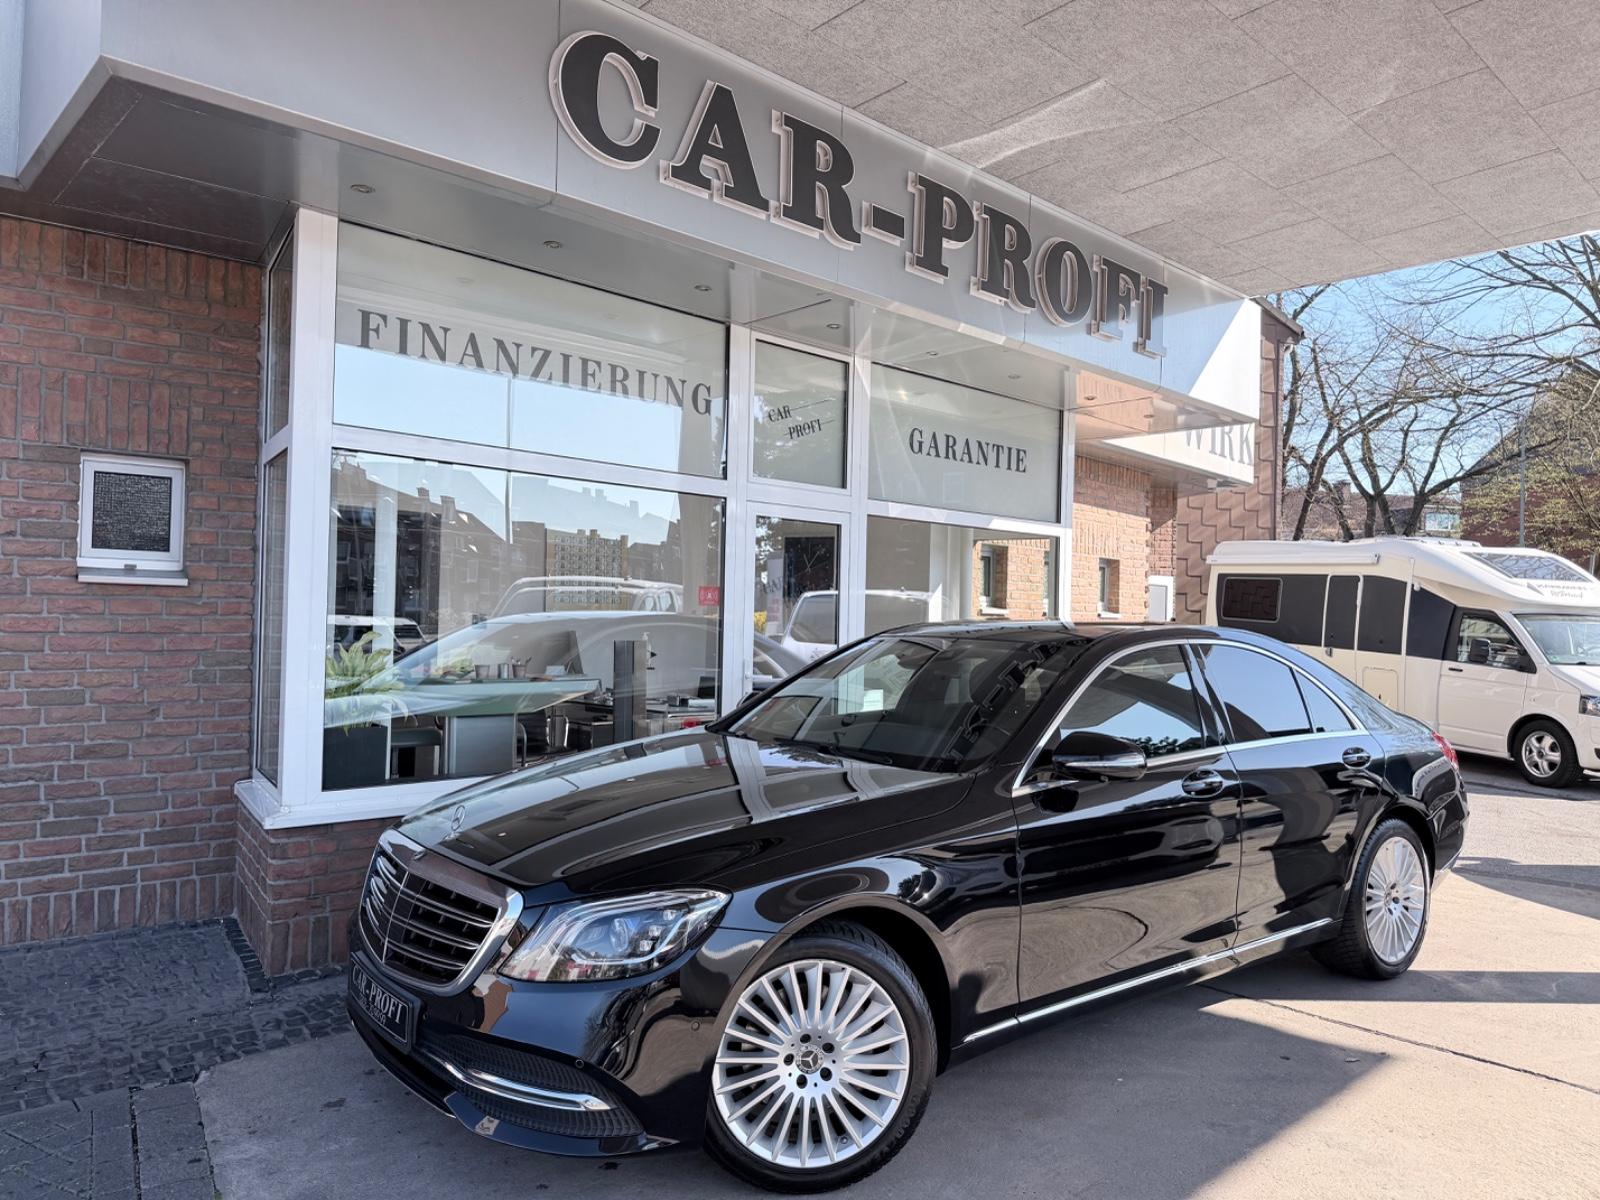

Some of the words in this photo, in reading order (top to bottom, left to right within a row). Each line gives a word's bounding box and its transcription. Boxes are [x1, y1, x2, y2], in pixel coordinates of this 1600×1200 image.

[549, 30, 1169, 359] CAR-PROFI
[357, 308, 713, 416] FINANZIERUNG
[768, 404, 792, 423] CAR
[787, 418, 822, 440] PROFI
[908, 427, 1028, 473] GARANTIE
